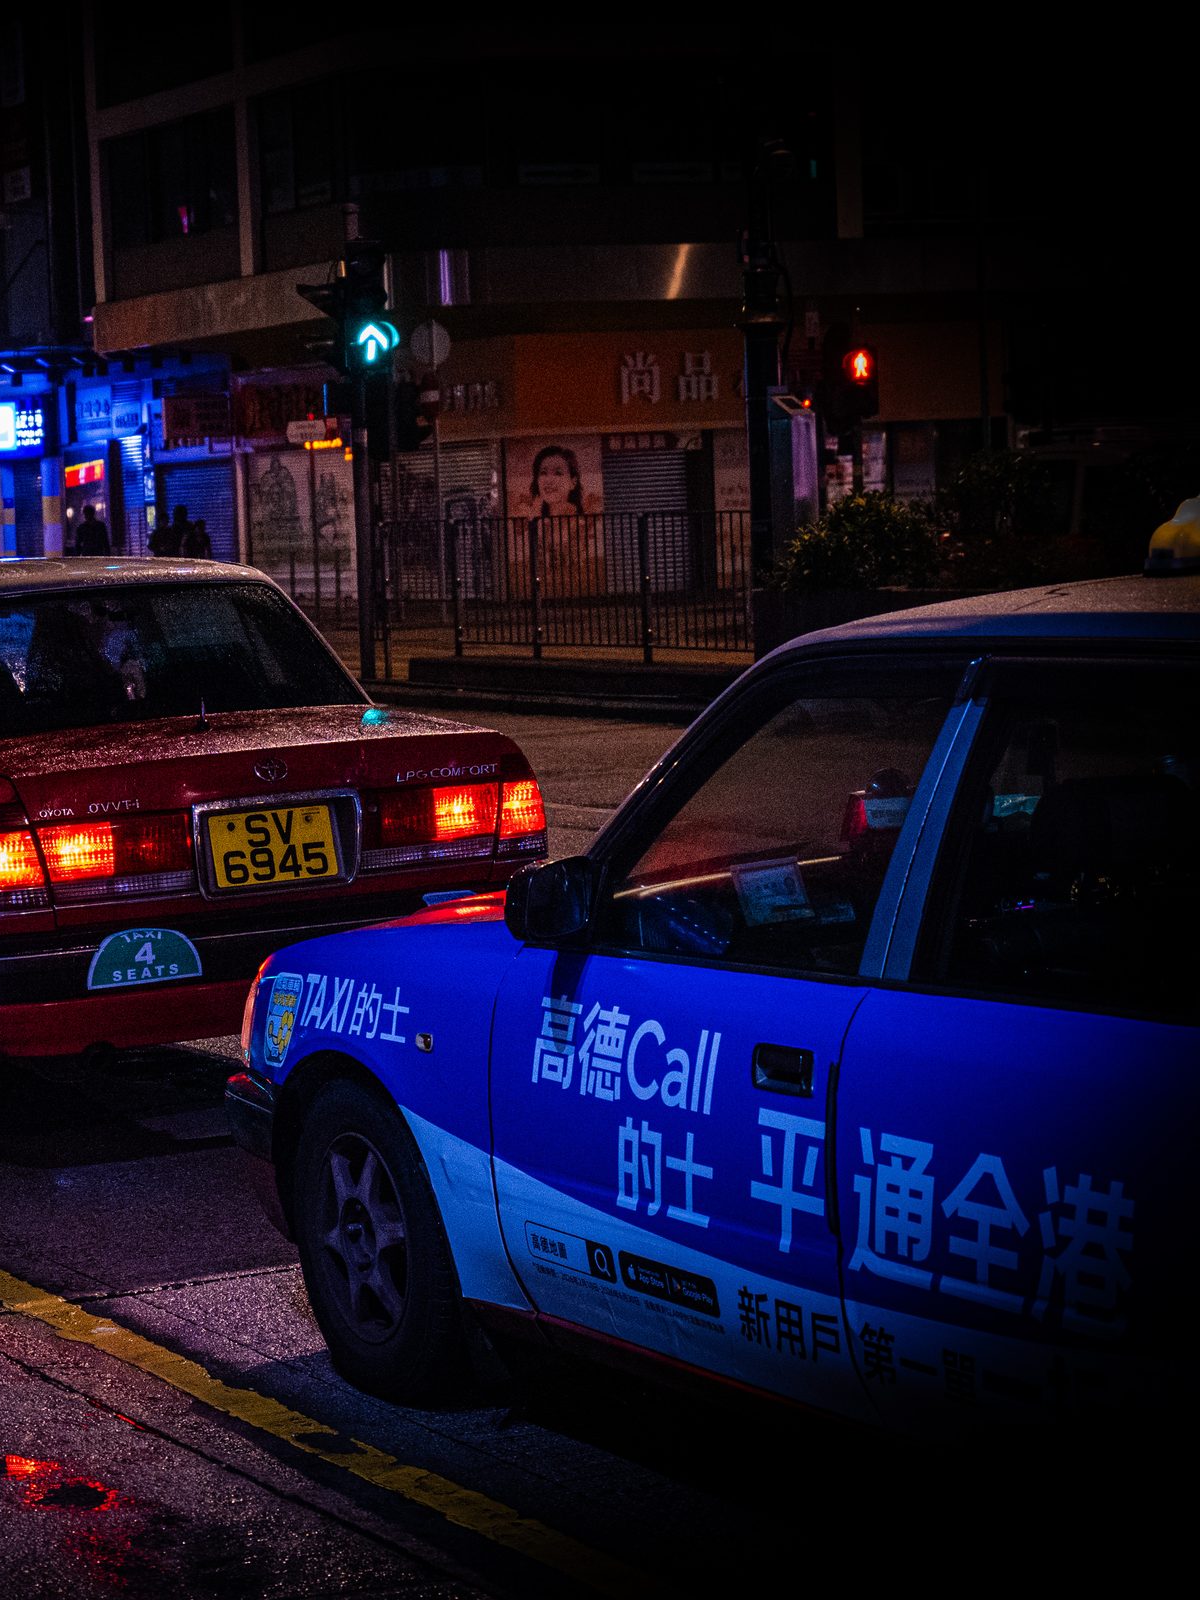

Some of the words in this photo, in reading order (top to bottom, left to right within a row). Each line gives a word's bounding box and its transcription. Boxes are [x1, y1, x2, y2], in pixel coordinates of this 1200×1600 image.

[620, 350, 746, 405] 尚品
[395, 769, 428, 783] LPG
[430, 762, 499, 778] COMFORT
[244, 810, 294, 848] SV
[222, 841, 329, 885] 6945
[119, 930, 163, 943] TAXI
[133, 941, 156, 965] 4
[112, 963, 179, 982] SEATS
[531, 994, 722, 1116] 高德Call
[616, 1116, 714, 1230] 的士
